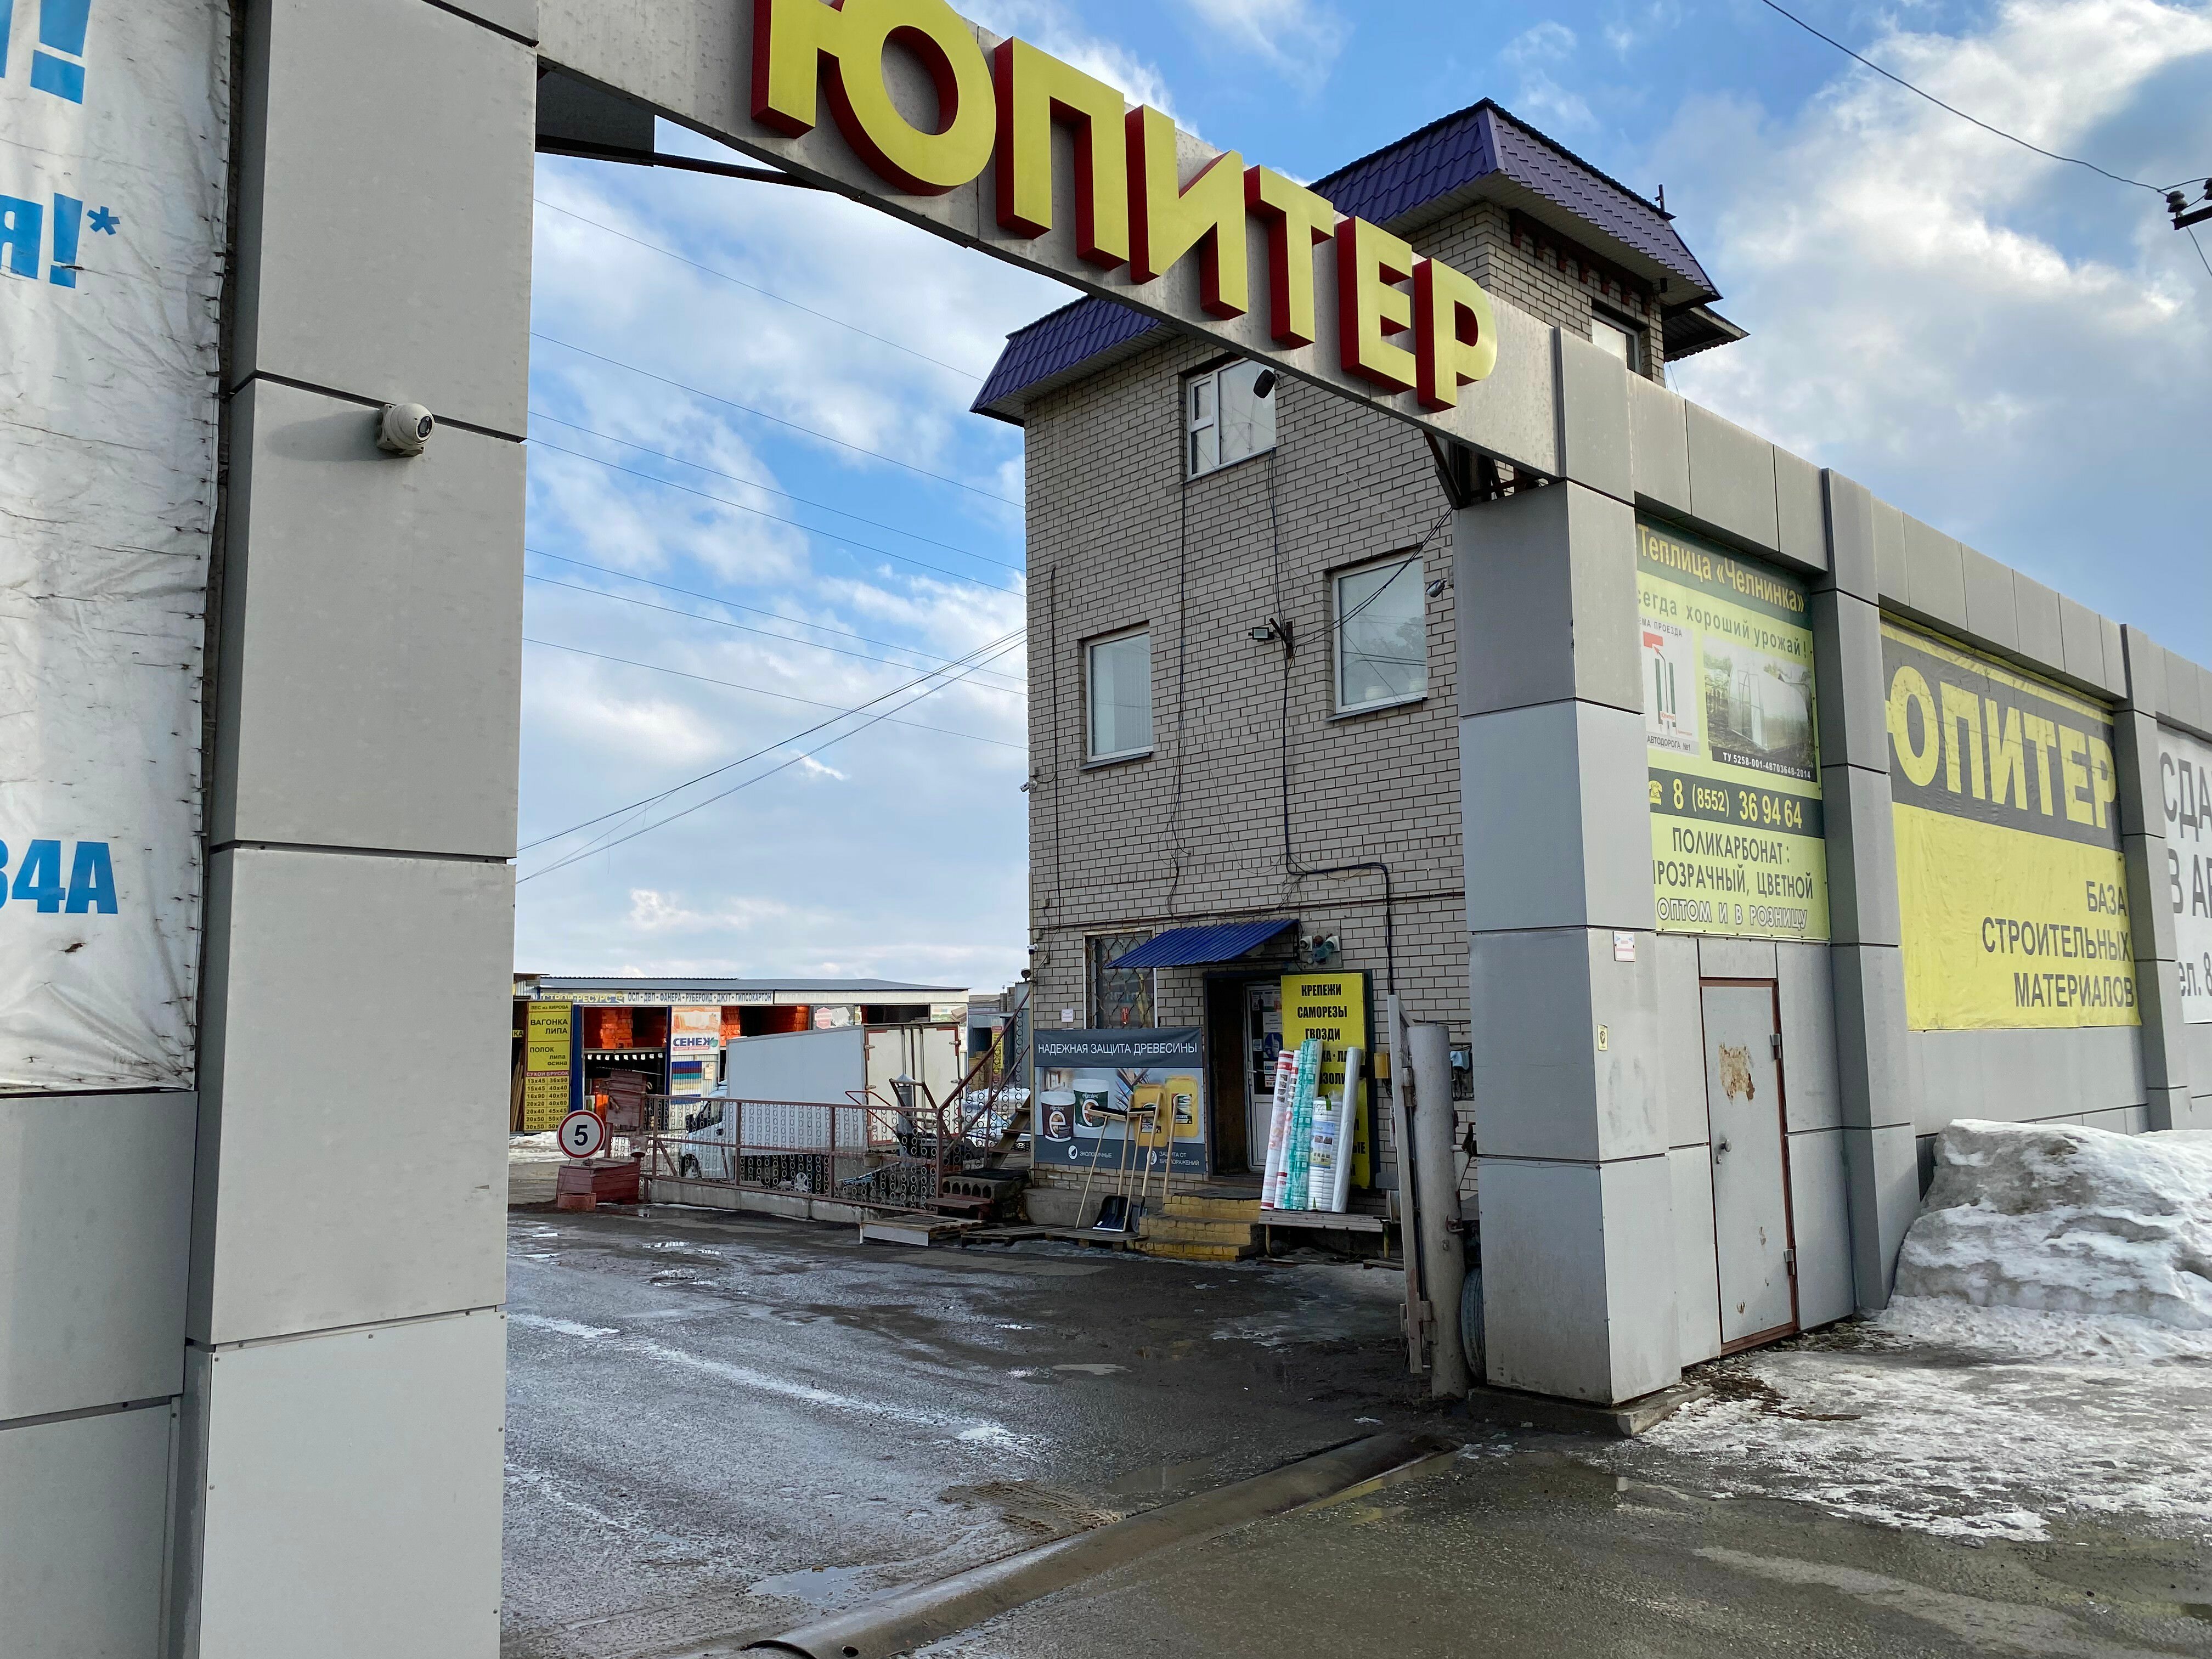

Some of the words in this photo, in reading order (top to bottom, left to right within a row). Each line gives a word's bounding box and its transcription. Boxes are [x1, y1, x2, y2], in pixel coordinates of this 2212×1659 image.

[752, 0, 1498, 411] ЮПИТЕР
[1638, 523, 1712, 583] Теплица
[1717, 557, 1804, 612] «Челнинка»
[1654, 621, 1683, 637] ПРОЕЗДА
[1686, 605, 1750, 639] хороший
[1647, 735, 1681, 749] АВТОДОРОГА
[1723, 752, 1731, 762] ТУ
[1673, 778, 1684, 810] 8
[1692, 783, 1729, 817] (8552)
[1739, 791, 1758, 822] 36
[1762, 795, 1781, 825] 94
[1784, 799, 1802, 828] 64
[2160, 752, 2212, 842] СДА
[0, 839, 118, 914] 4А
[1652, 860, 1750, 896] РОЗРАЧНЫЙ,
[1757, 872, 1813, 899] ЦВЕТНОЙ
[1657, 897, 1713, 923] ОПТОМ
[1718, 902, 1729, 924] И
[1734, 904, 1743, 925] В
[1750, 905, 1808, 932] РОЗНИЦУ
[2086, 881, 2128, 917] БАЗА
[1982, 917, 2131, 961] СТРОИТЕЛЬНЫХ
[660, 992, 681, 1002] ФАНЕРА
[735, 992, 771, 1002] ГИПСОКАРТОН
[1301, 984, 1341, 996] КРЕПЕЖИ
[2014, 972, 2135, 1007] МАТЕРИАЛОВ
[1297, 1006, 1347, 1018] САМОРЕЗЫ
[1038, 1043, 1088, 1056] НАДЕЖНАЯ
[1091, 1043, 1132, 1057] ЗАЩИТА
[1133, 1042, 1198, 1056] ДРЕВЕСИНЫ
[1305, 1028, 1340, 1041] ГВОЗДИ
[574, 1124, 588, 1146] 5
